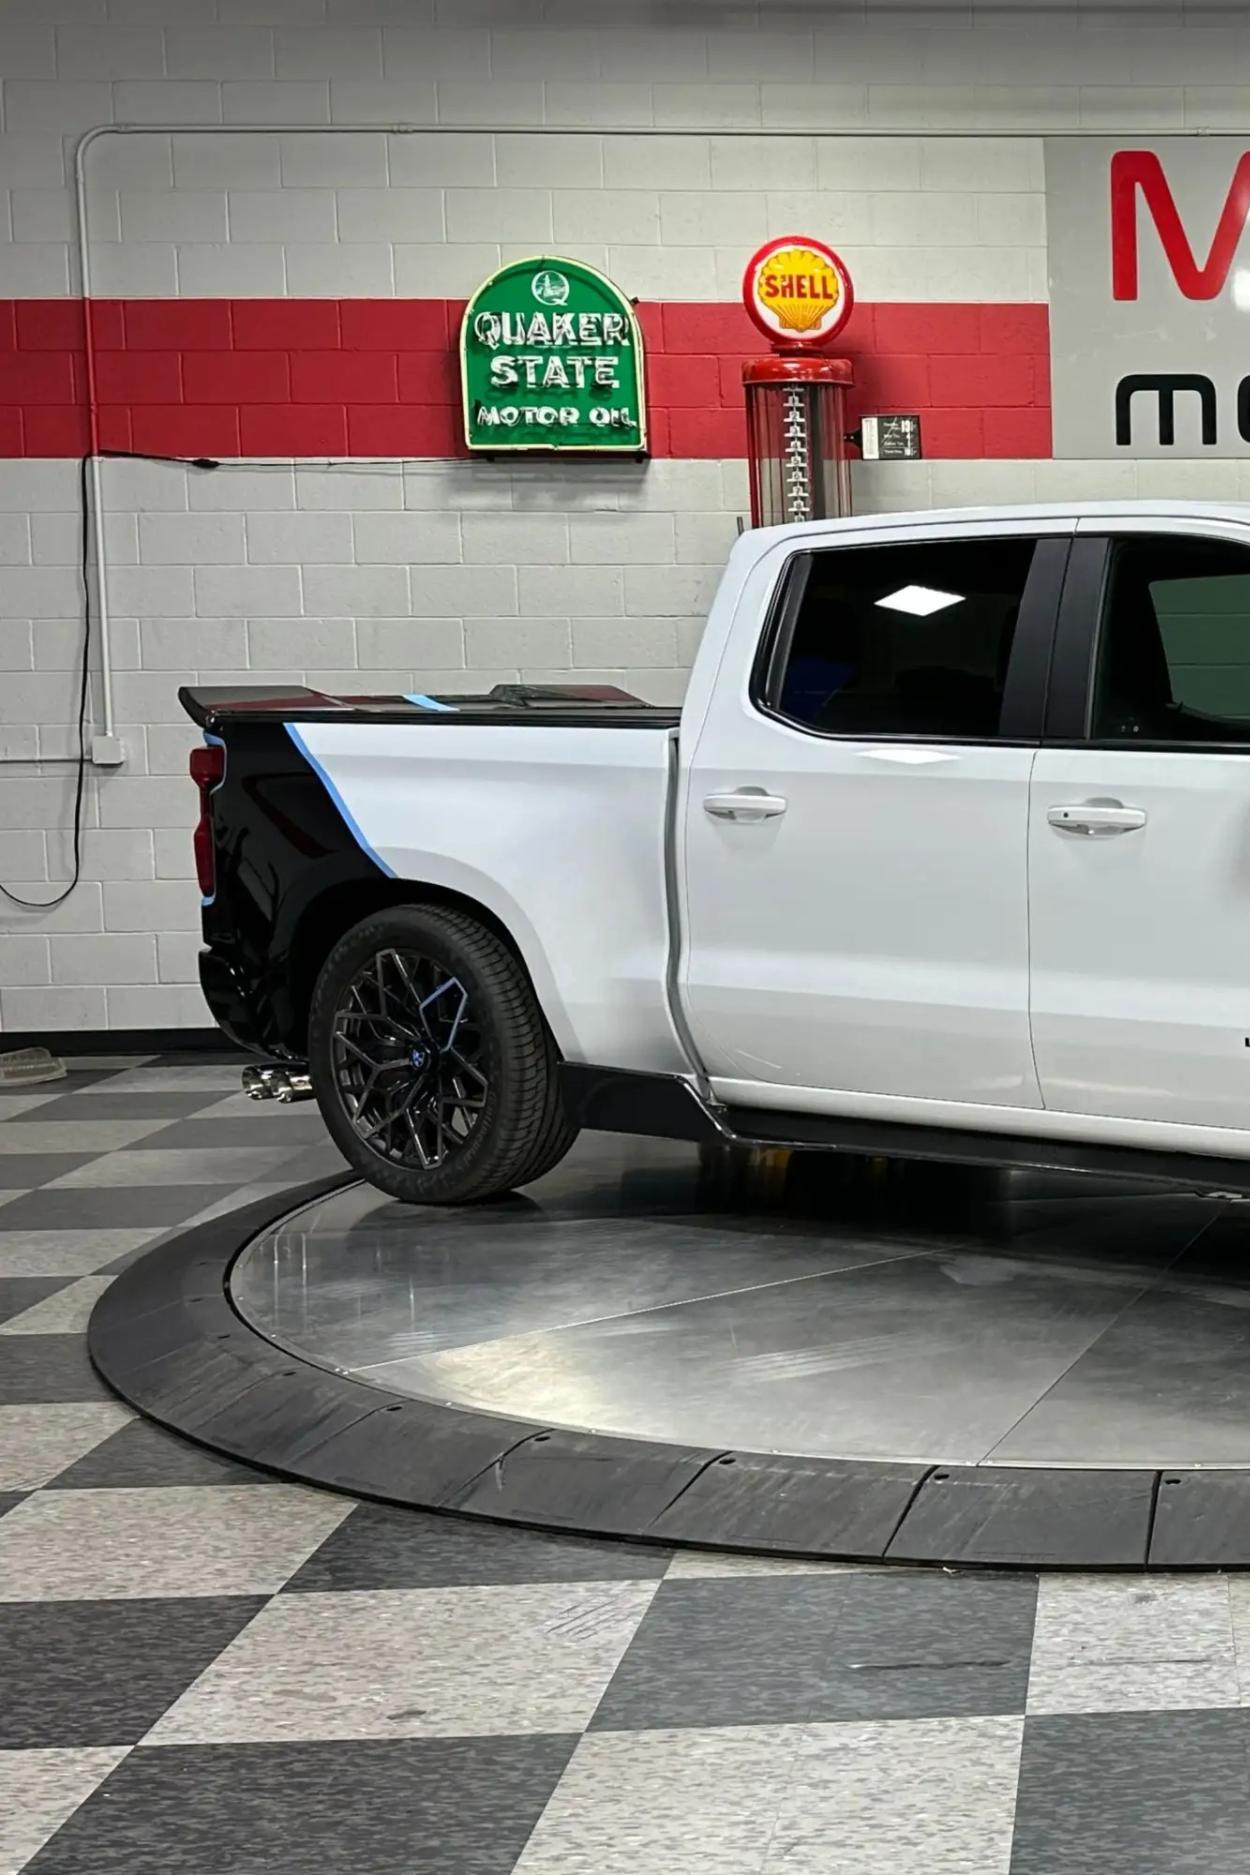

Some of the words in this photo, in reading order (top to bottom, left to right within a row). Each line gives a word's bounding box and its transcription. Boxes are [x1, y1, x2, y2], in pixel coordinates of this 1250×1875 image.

[764, 274, 834, 300] SHELL
[474, 312, 631, 350] QUAKER
[490, 355, 620, 389] STATE
[477, 406, 580, 427] MOTOR
[589, 406, 637, 427] OIL
